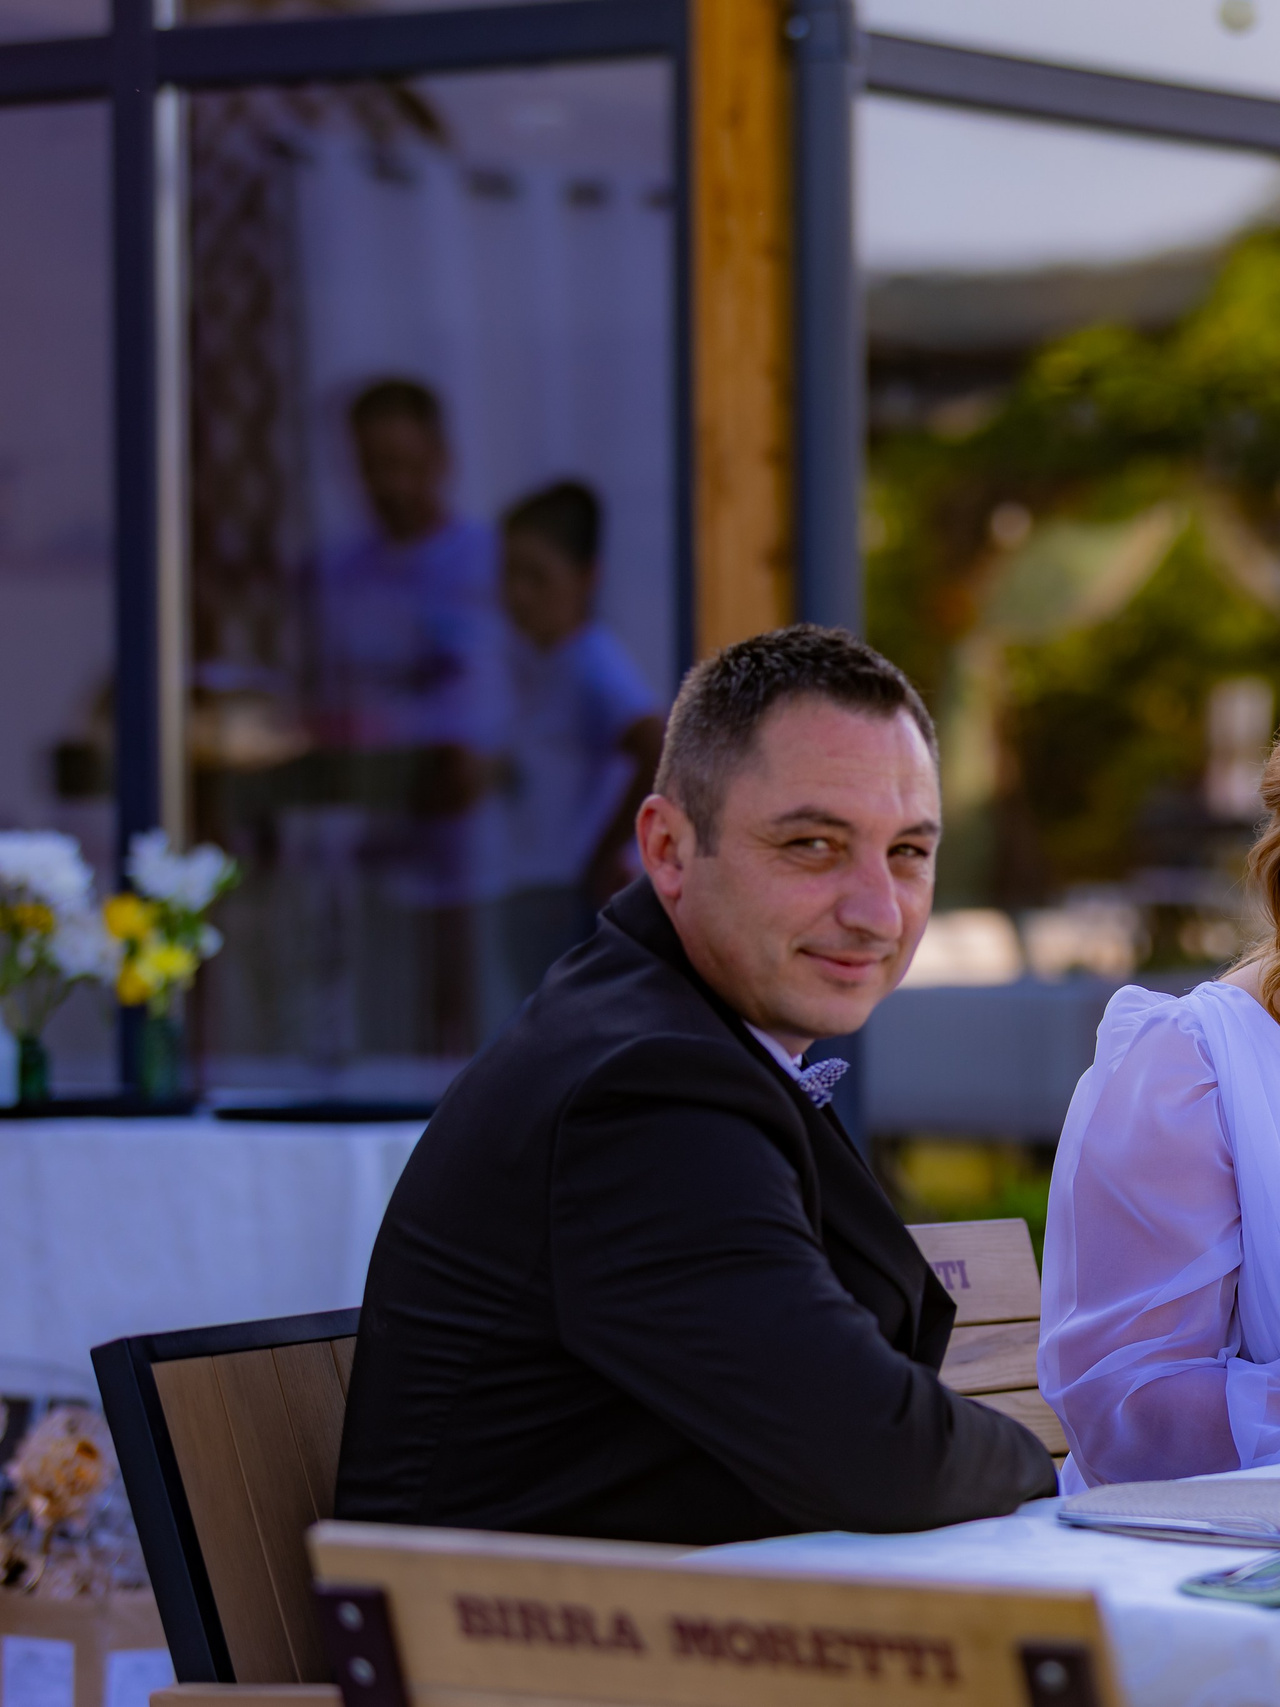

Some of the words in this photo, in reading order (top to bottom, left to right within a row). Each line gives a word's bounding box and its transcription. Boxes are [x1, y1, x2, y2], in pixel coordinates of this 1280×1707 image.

[931, 1260, 971, 1290] TI
[454, 1595, 647, 1654] BIRRA
[669, 1613, 962, 1686] MORETTI
